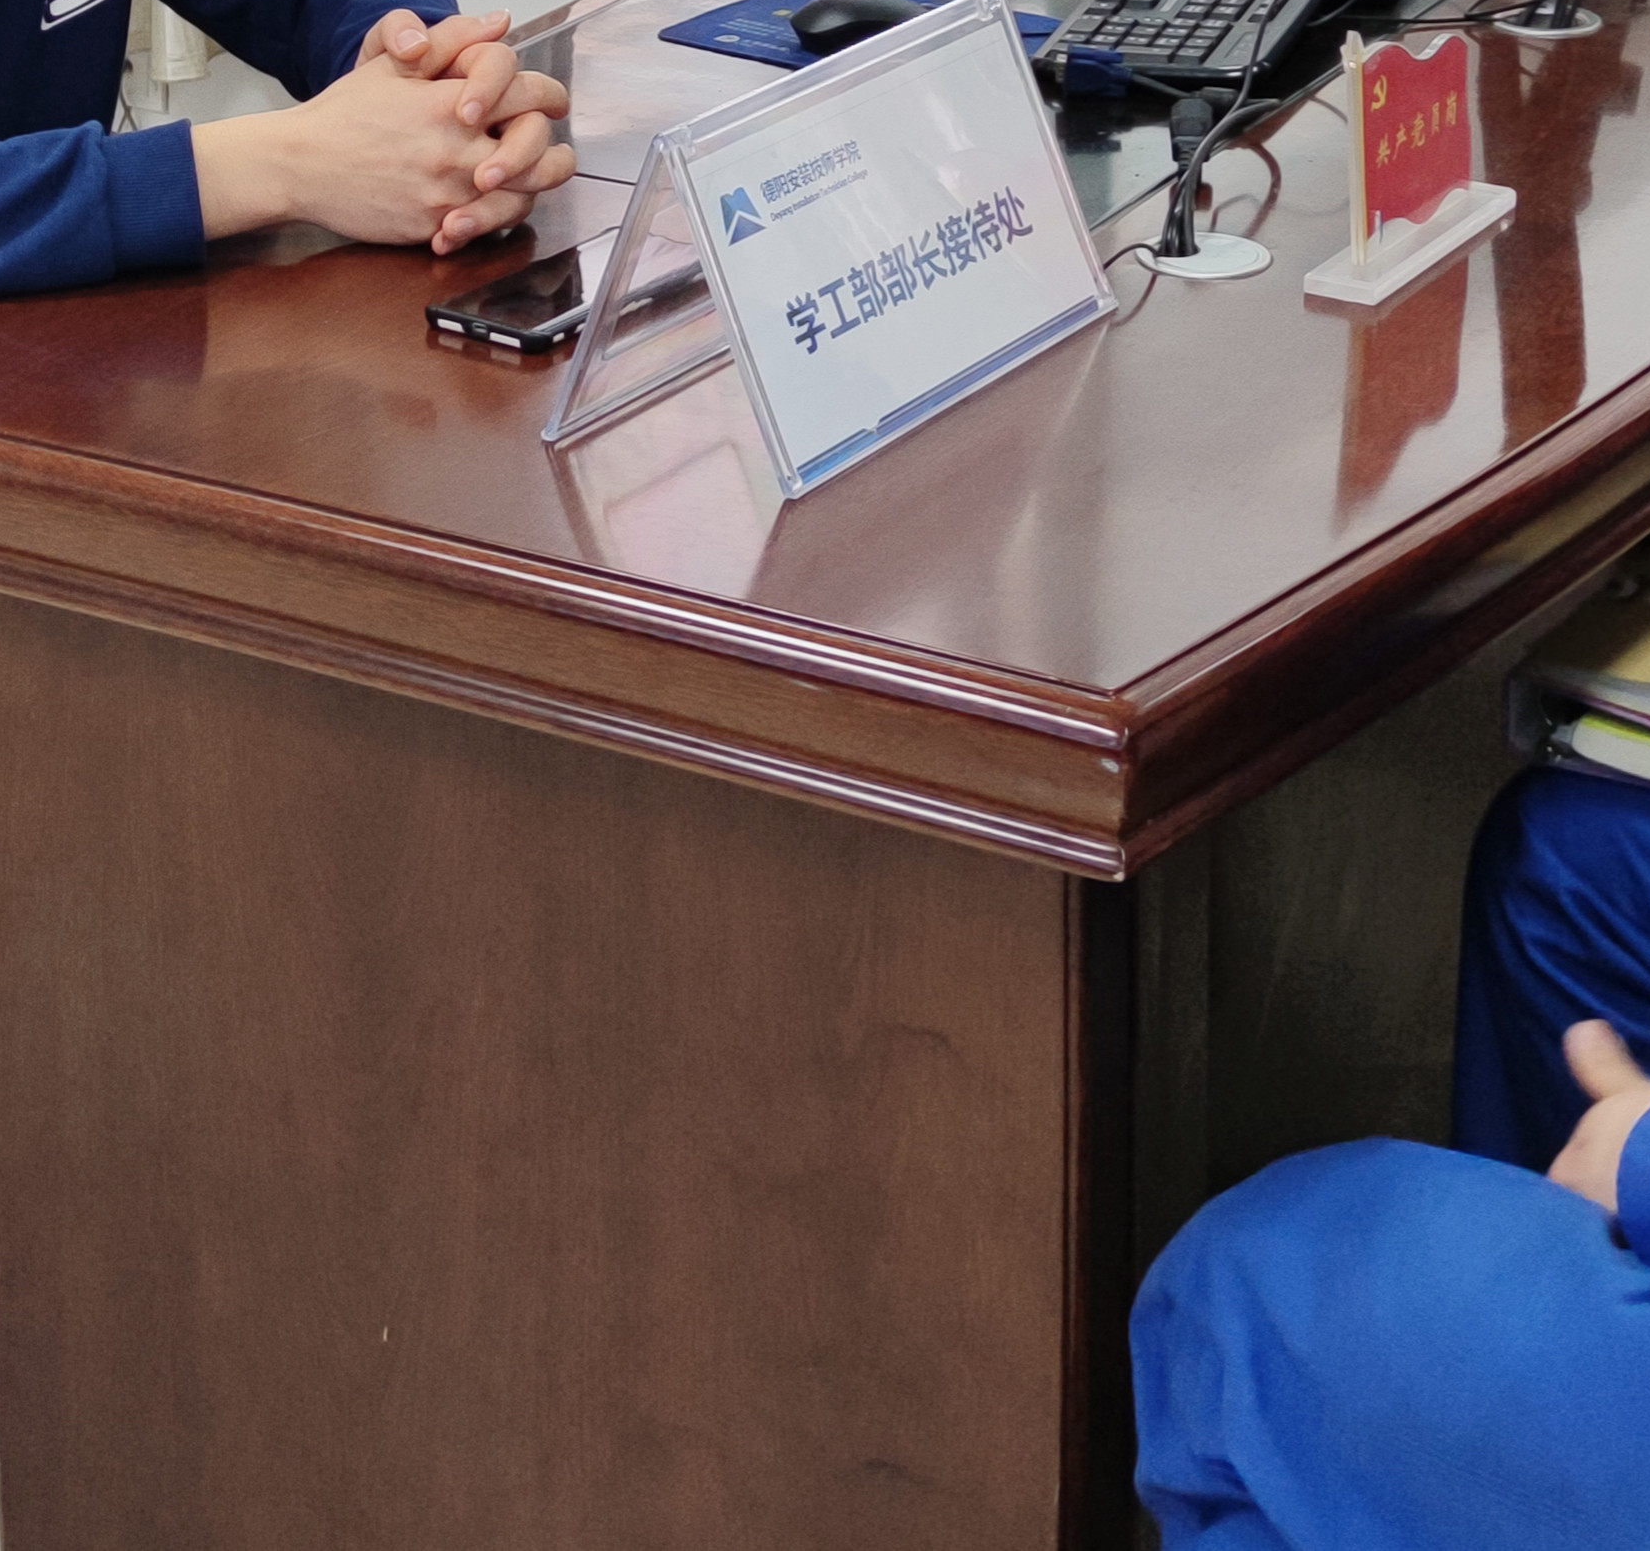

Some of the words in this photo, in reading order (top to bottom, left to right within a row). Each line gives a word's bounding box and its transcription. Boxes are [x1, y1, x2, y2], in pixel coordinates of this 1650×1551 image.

[760, 139, 862, 204] 德阳安装技师学院
[786, 185, 1034, 355] 学工部部长接待处
